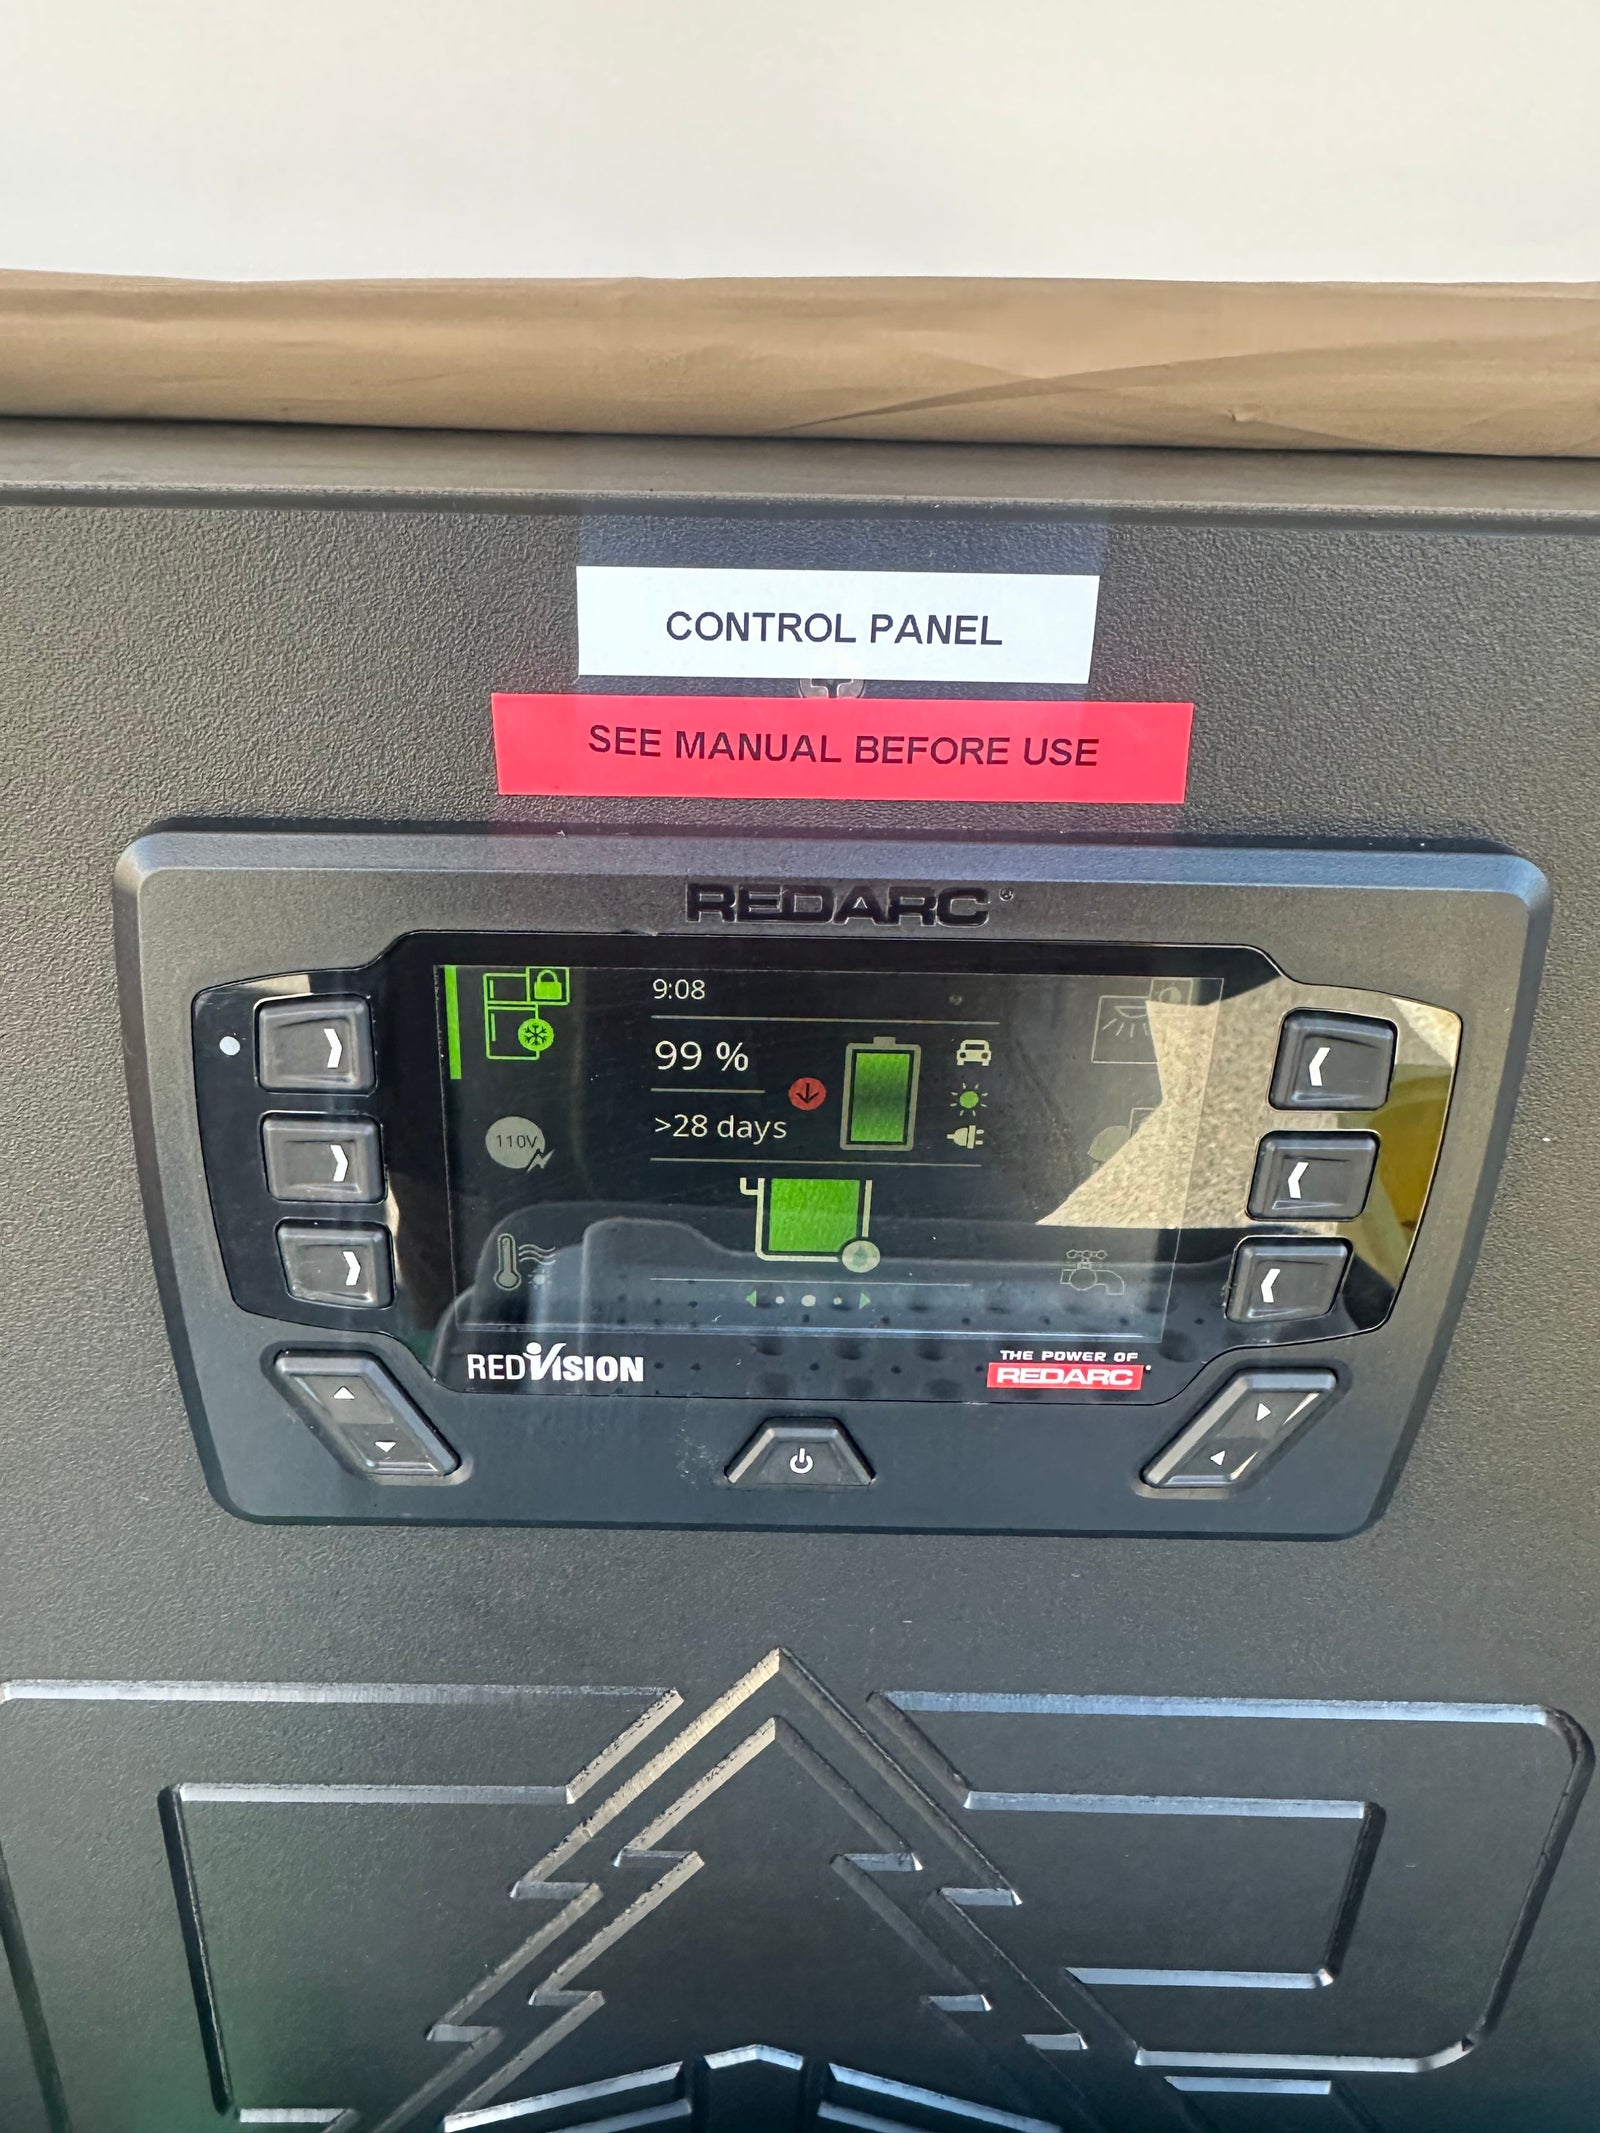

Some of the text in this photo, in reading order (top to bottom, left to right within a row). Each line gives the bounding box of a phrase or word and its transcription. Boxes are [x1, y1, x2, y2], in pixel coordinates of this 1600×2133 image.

[665, 611, 1003, 646] CONTROL PANEL
[588, 724, 1099, 767] SEE MANUAL BEFORE USE
[686, 883, 990, 926] REDARC
[652, 978, 706, 1001] 9:08
[654, 1040, 750, 1072] 99 %
[495, 1134, 539, 1150] 110V
[654, 1113, 788, 1145] >28 days
[1000, 1350, 1138, 1363] THE POWER OF
[997, 1367, 1134, 1386] REDARC
